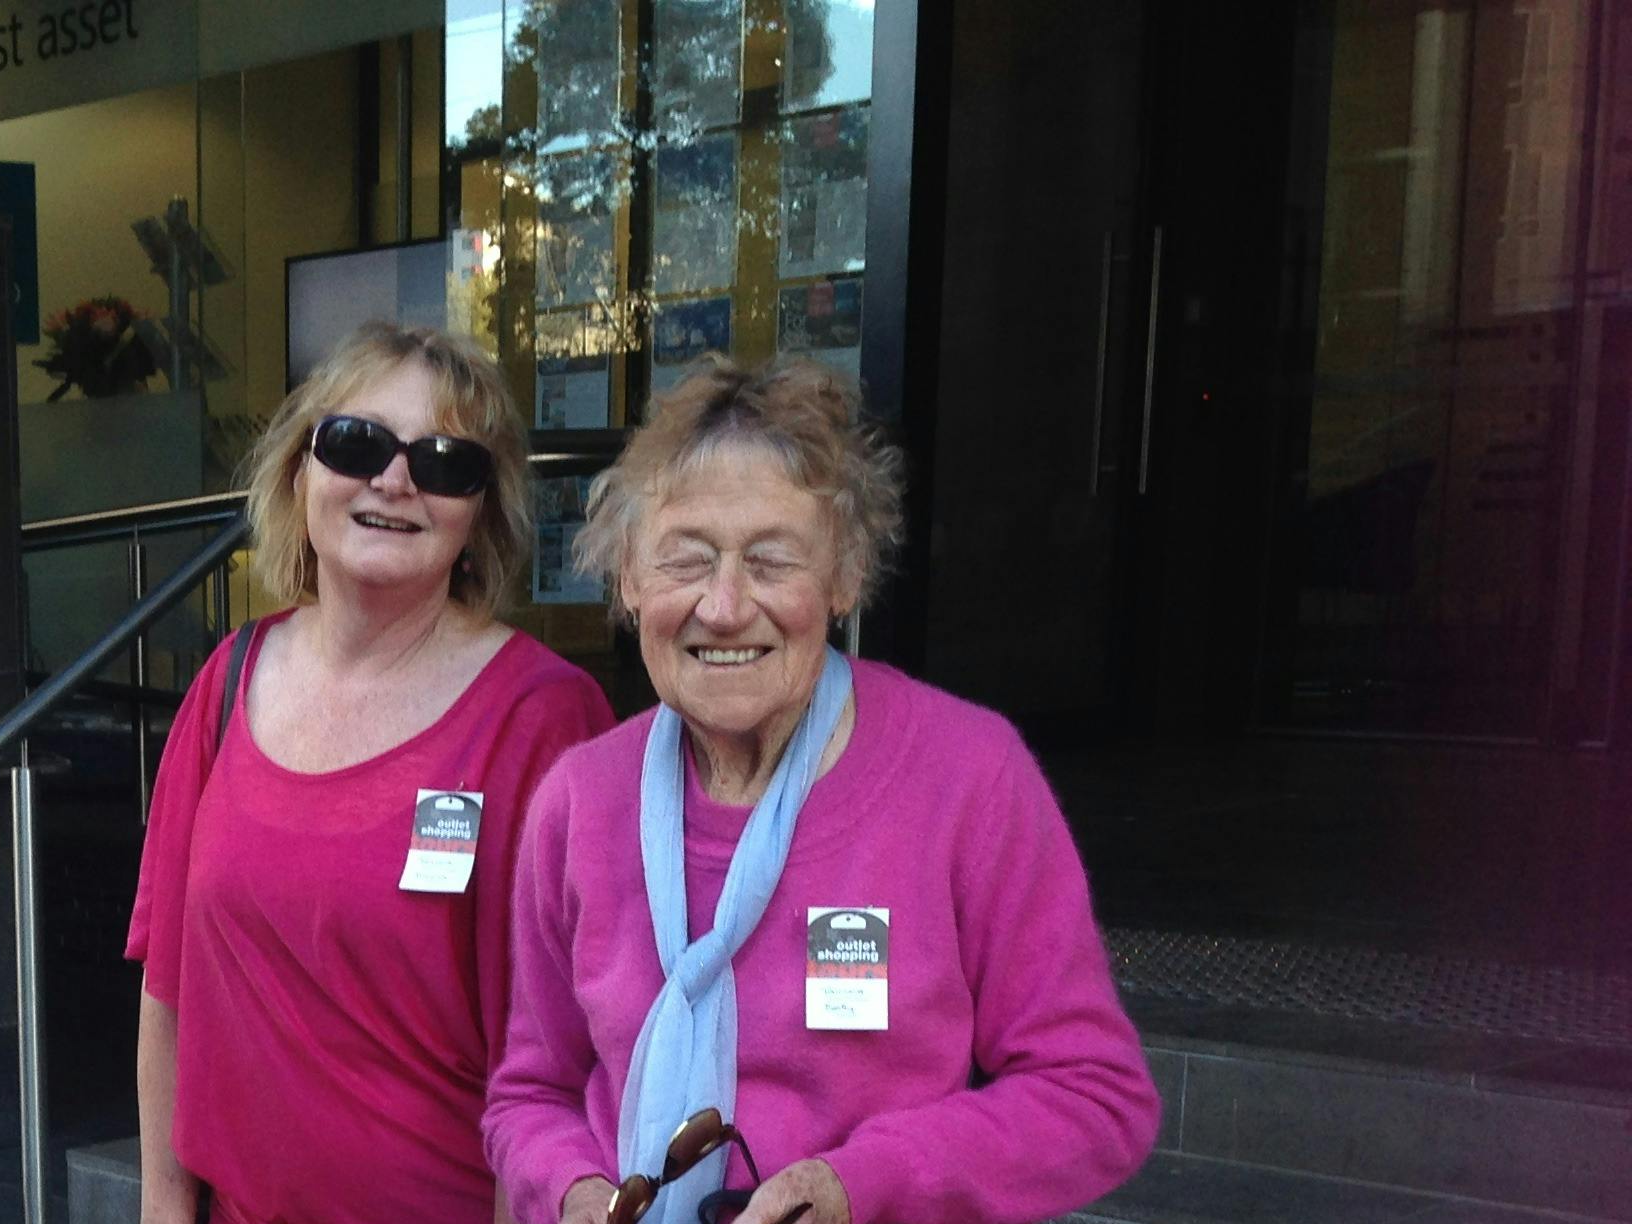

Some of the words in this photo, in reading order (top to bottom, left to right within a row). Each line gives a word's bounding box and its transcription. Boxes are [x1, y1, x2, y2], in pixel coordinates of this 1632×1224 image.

[38, 0, 139, 61] asset
[836, 938, 877, 952] outlet
[817, 948, 879, 963] shopping
